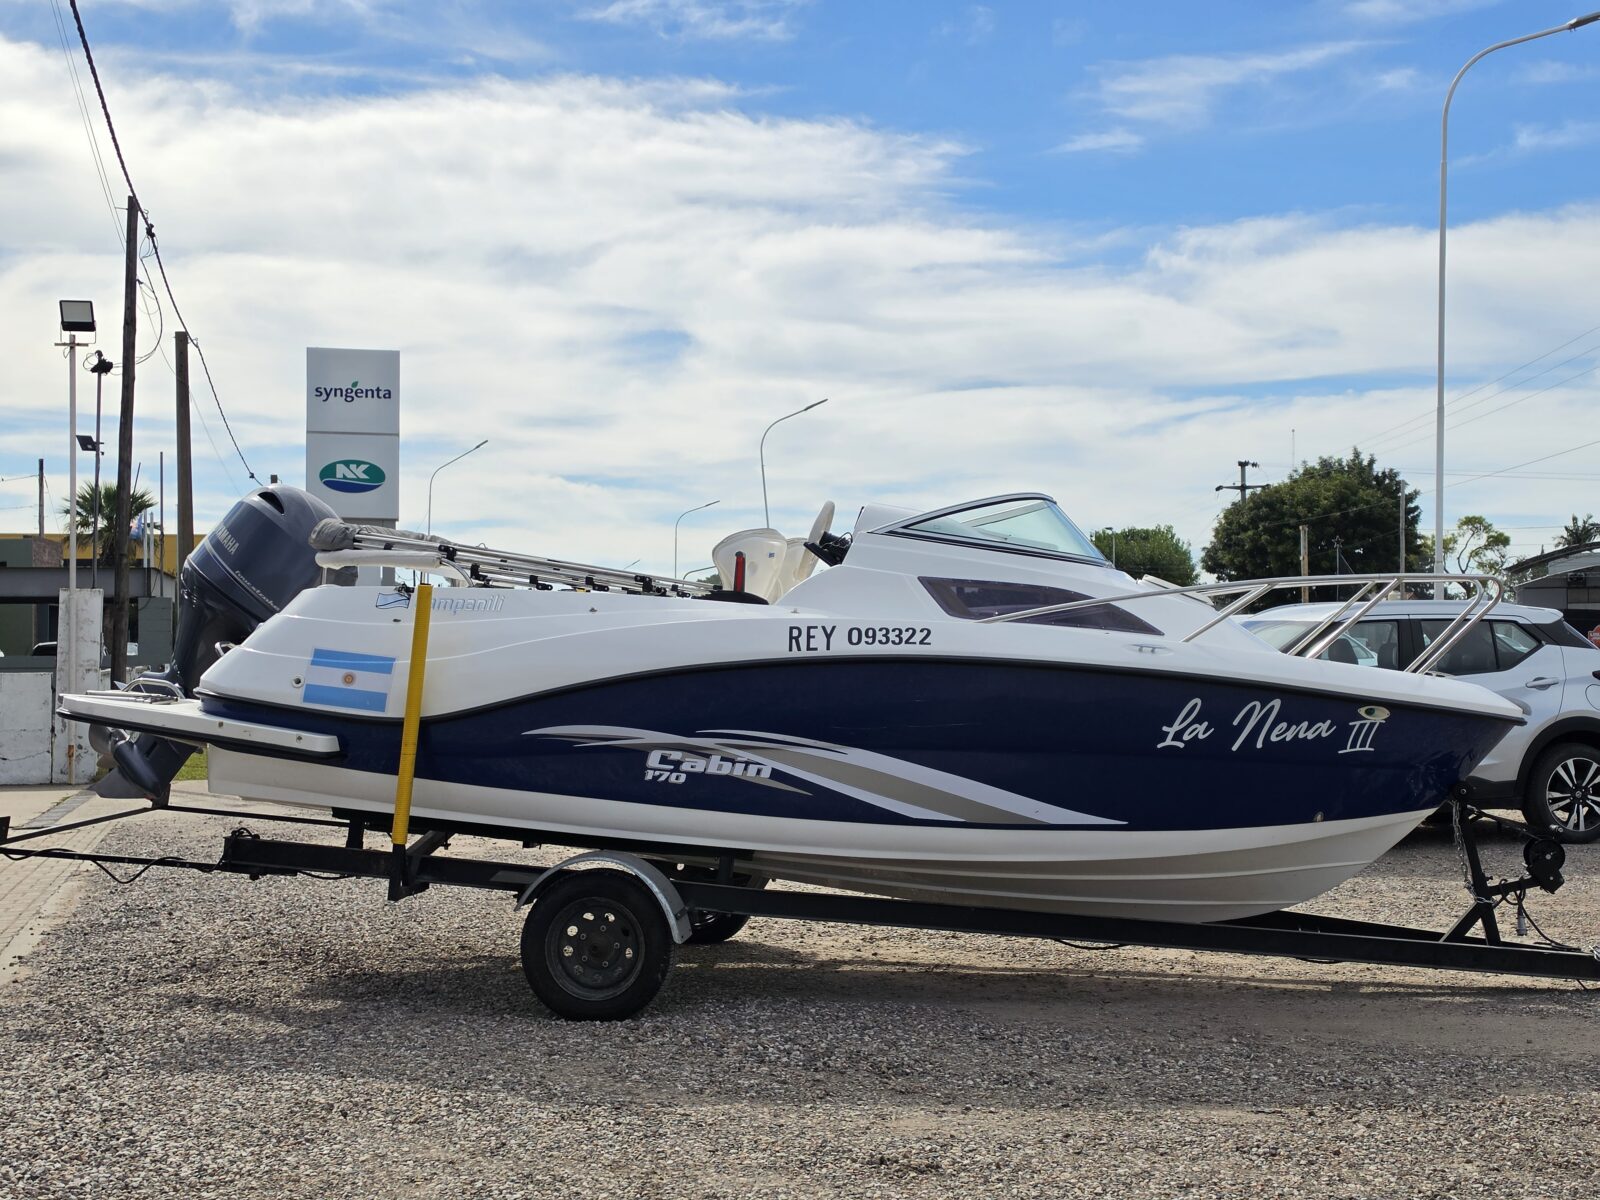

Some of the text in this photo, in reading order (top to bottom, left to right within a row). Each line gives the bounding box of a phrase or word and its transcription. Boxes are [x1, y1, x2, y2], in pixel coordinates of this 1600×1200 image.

[314, 386, 392, 403] syngenta
[336, 463, 370, 479] NK
[216, 525, 240, 555] YAMAHA
[788, 625, 932, 652] REY 093322
[1156, 697, 1387, 754] La Nena III
[644, 769, 687, 785] 170
[646, 749, 773, 779] Cabin
